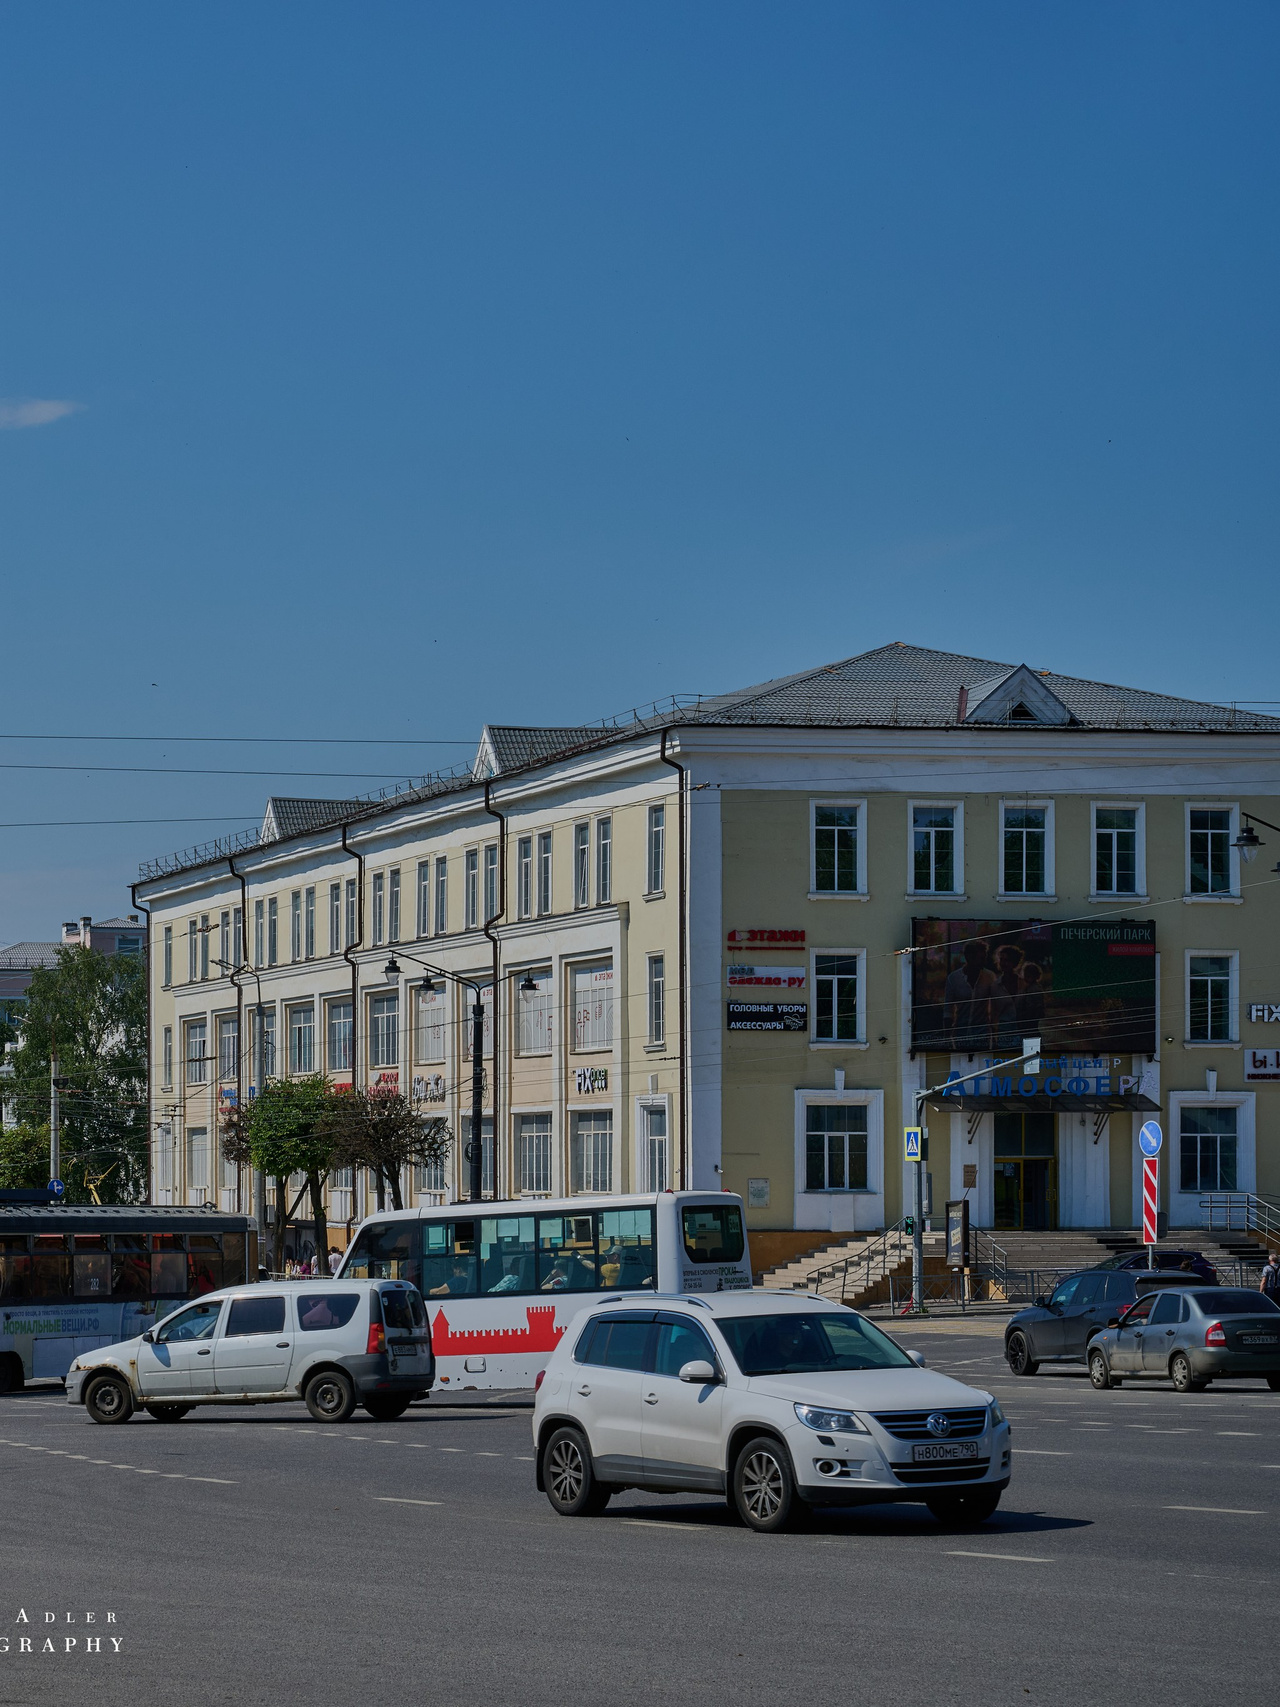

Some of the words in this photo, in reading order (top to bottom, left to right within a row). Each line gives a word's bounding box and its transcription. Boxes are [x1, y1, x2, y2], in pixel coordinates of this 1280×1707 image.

[1061, 925, 1121, 940] ПЕЧЕРСКИЙ
[1124, 927, 1151, 940] ПАРК
[729, 1004, 774, 1012] ГОЛОВНЫЕ
[777, 1005, 807, 1013] УБОРЫ
[730, 1021, 784, 1030] АКСЕССУАРЫ
[959, 1443, 975, 1453] 790
